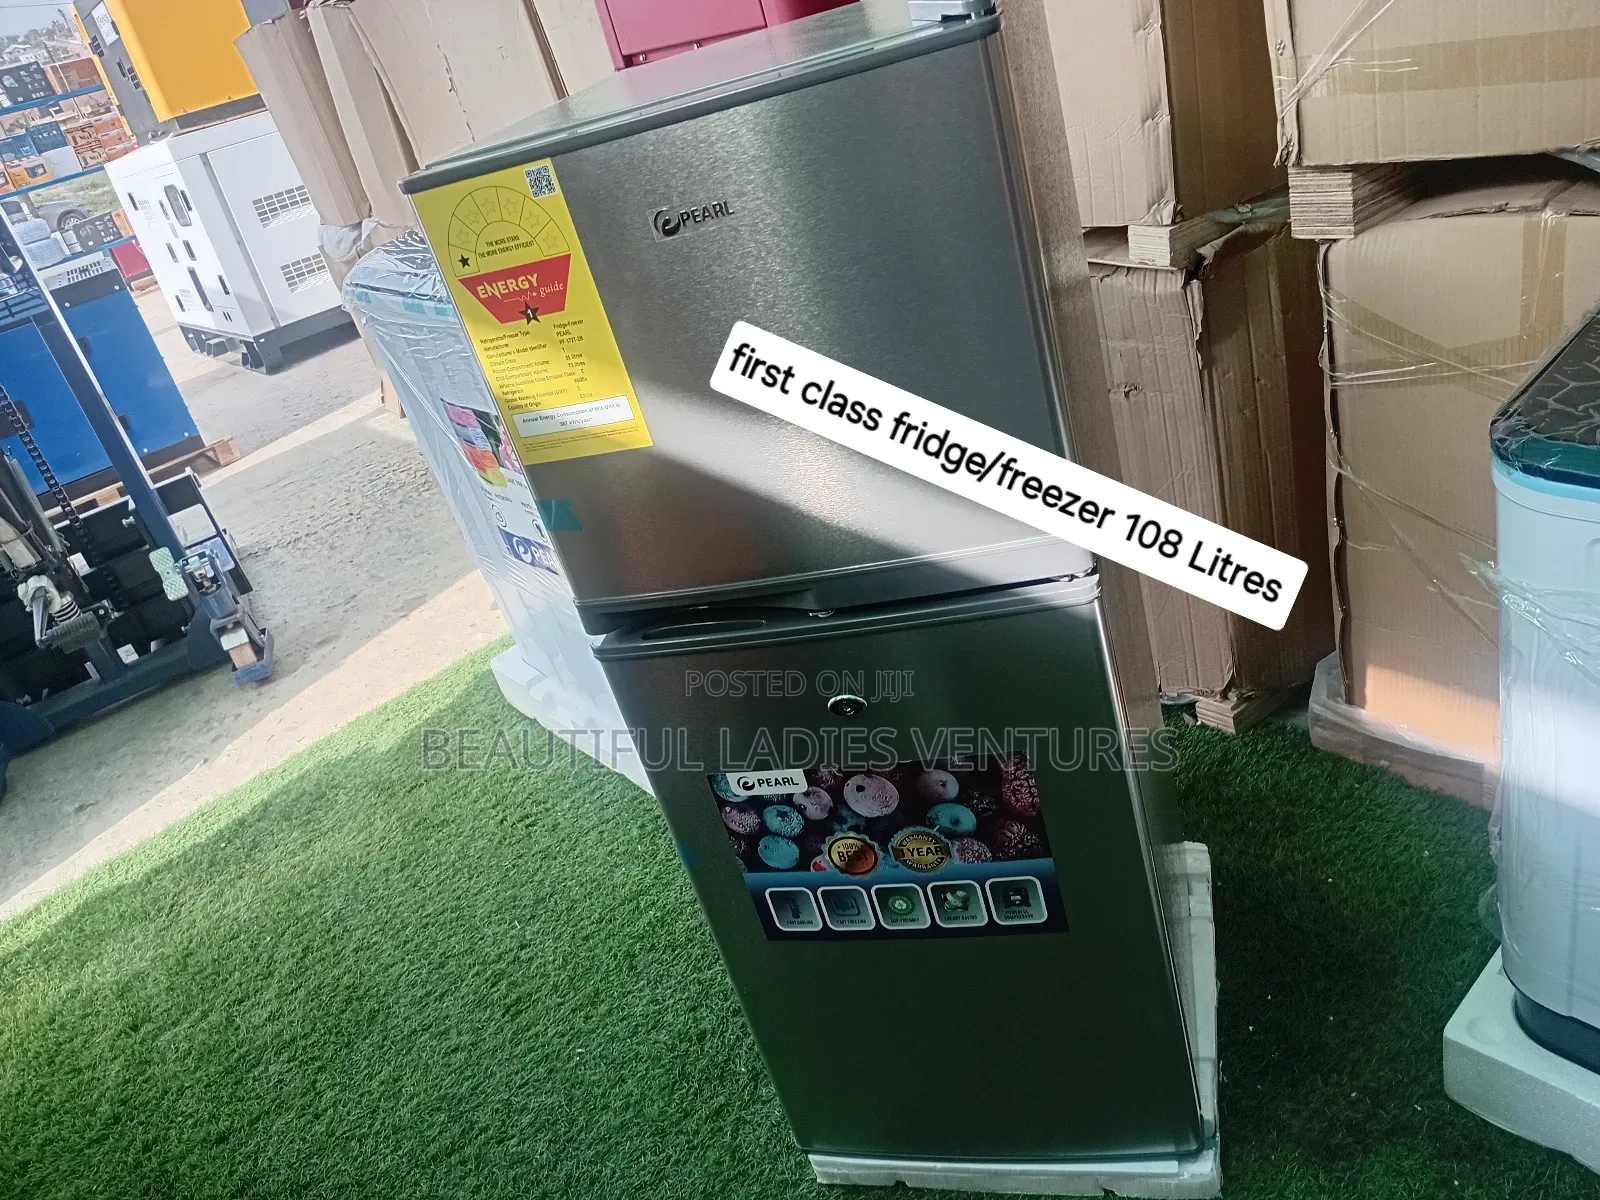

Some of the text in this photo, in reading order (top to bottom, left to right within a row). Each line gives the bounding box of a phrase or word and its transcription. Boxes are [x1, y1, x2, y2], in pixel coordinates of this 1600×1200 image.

[680, 199, 734, 226] PEARL
[486, 249, 498, 257] MORE
[476, 273, 564, 299] ENERGY guide
[527, 309, 533, 318] 1
[539, 414, 556, 422] Energy
[756, 776, 800, 788] PEARL
[901, 834, 937, 846] WARRANTY
[841, 843, 860, 851] 100%
[906, 846, 945, 858] YEAR
[906, 858, 942, 870] WARRANTY
